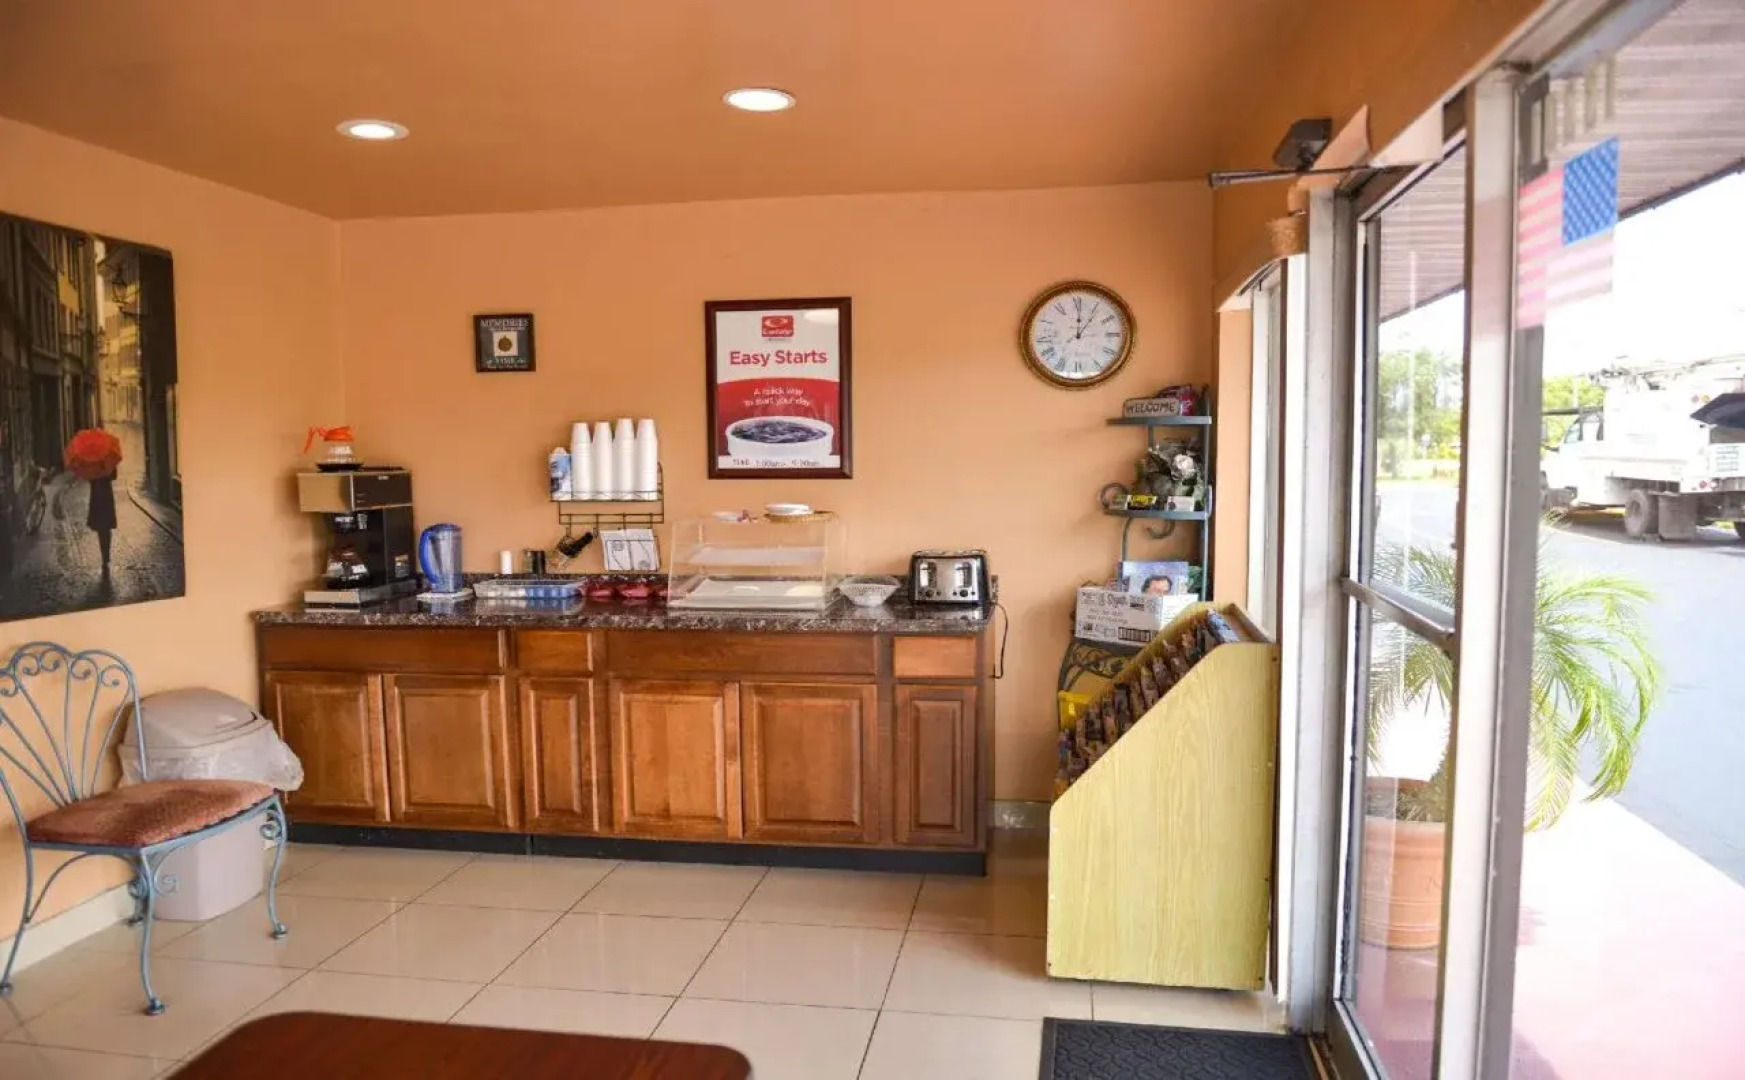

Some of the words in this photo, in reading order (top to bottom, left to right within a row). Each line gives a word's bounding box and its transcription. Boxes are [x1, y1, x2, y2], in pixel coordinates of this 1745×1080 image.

[730, 351, 770, 367] Easy
[775, 349, 827, 364] Starts
[753, 388, 761, 396] A
[1125, 402, 1176, 413] WELCOME
